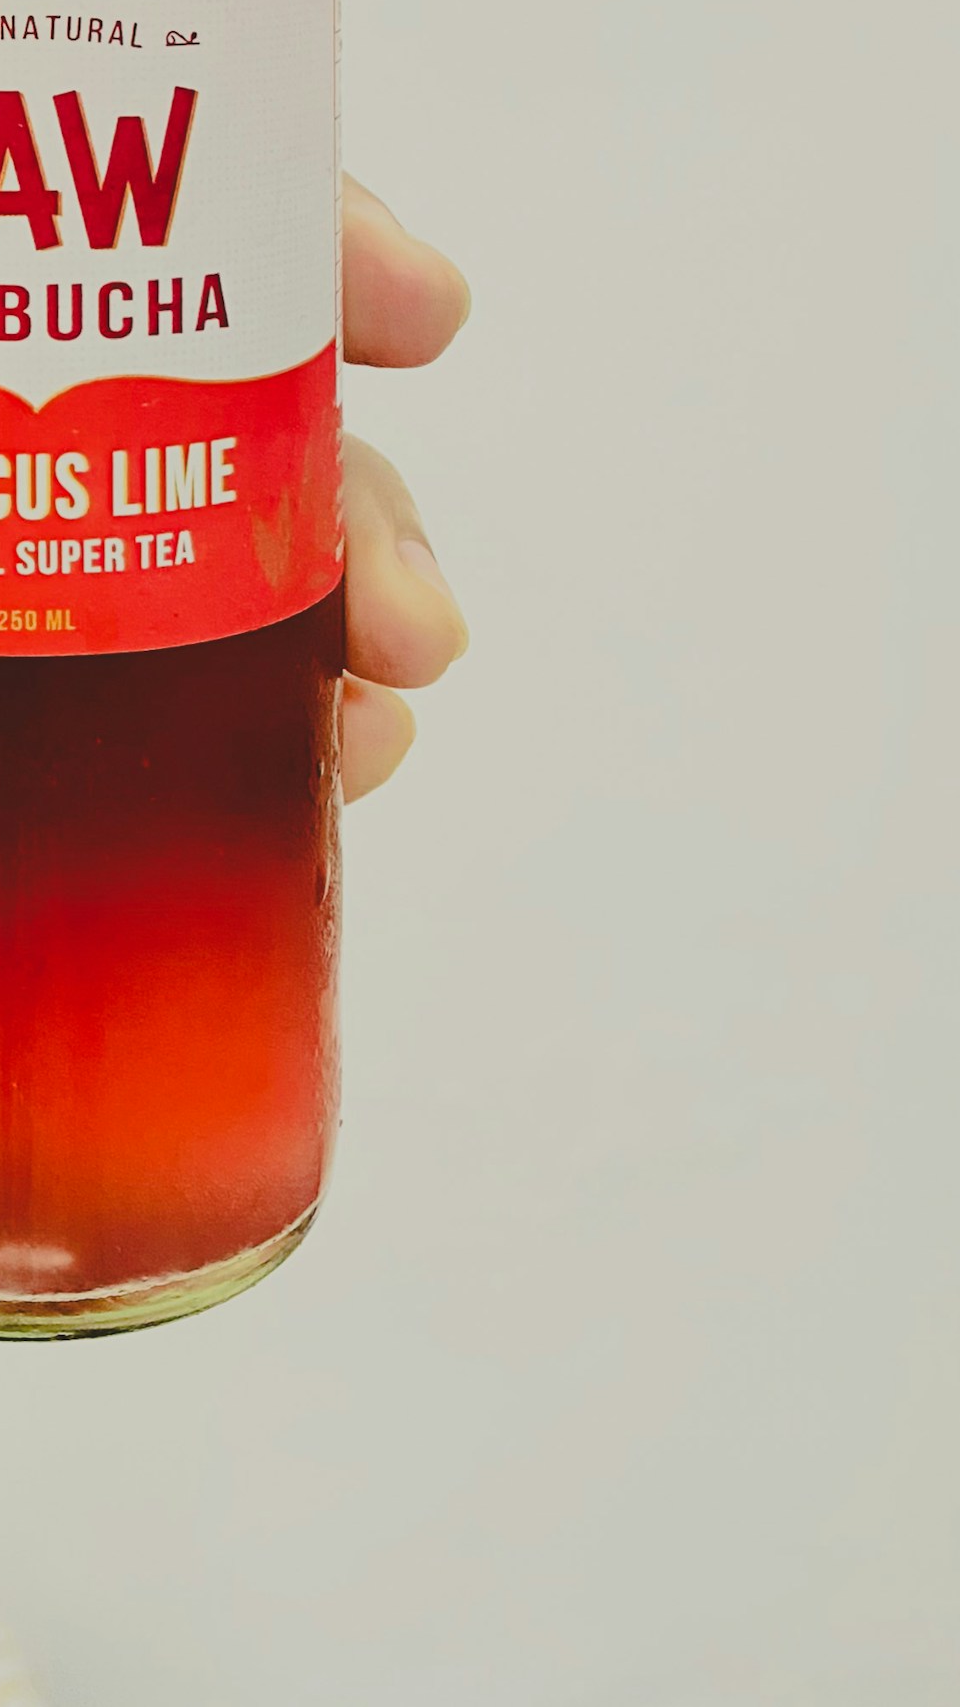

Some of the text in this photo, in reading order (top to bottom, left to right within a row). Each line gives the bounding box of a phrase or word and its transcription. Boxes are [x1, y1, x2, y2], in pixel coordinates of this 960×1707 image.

[0, 15, 143, 49] NATURAL
[112, 437, 237, 517] LIME
[16, 534, 125, 575] SUPER
[136, 530, 195, 570] TEA
[46, 609, 77, 631] ML
